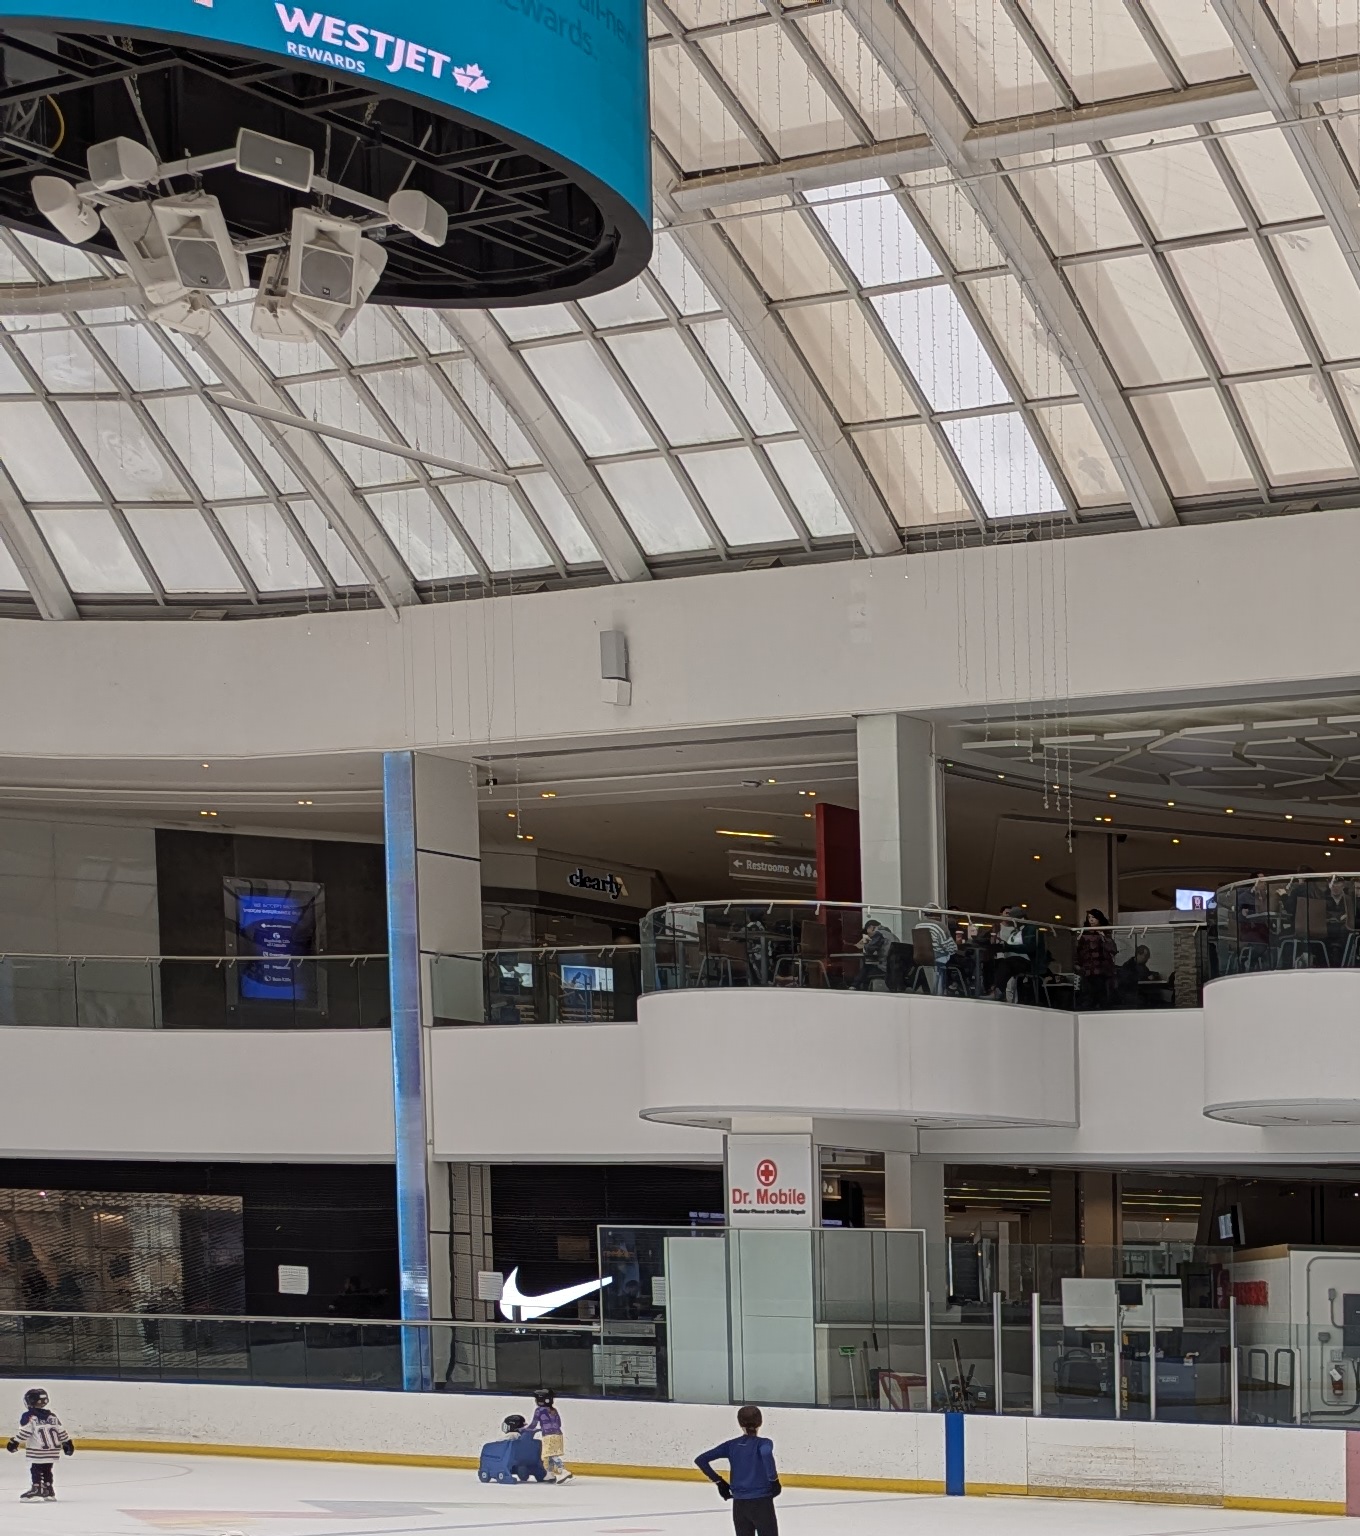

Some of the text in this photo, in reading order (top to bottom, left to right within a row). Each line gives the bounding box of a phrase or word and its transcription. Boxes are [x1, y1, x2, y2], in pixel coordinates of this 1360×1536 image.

[274, 2, 451, 78] WESTJET
[286, 40, 366, 73] REWARDS
[746, 860, 790, 873] Restrooms
[568, 868, 625, 899] clearly
[732, 1188, 806, 1204] Dr. Mobile
[38, 1427, 62, 1449] 10
